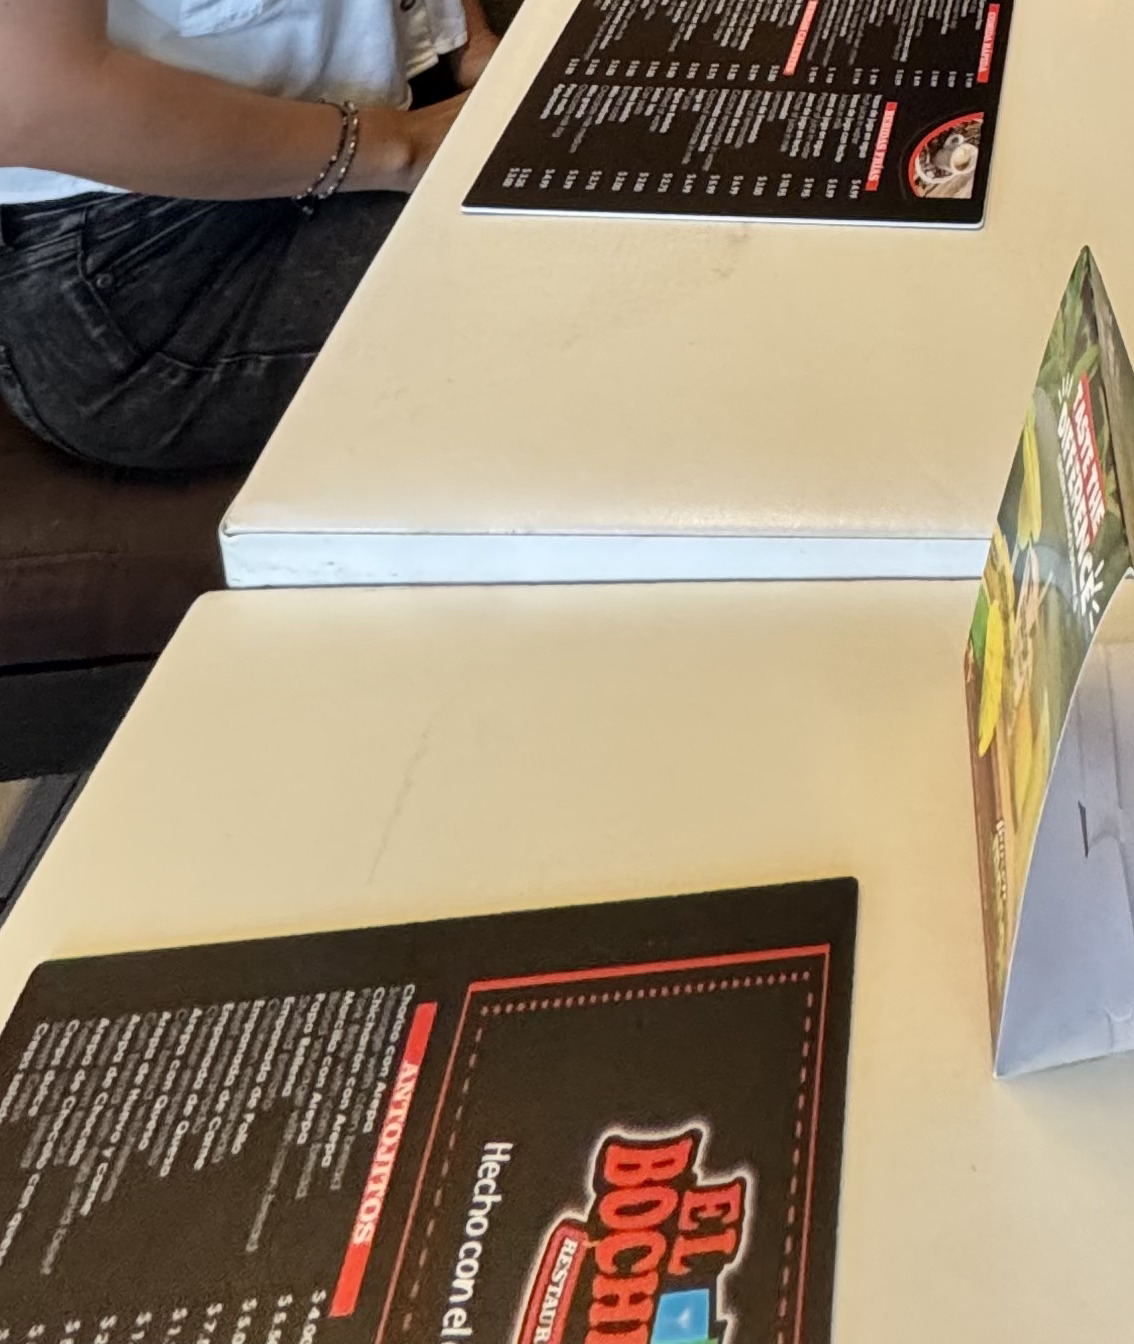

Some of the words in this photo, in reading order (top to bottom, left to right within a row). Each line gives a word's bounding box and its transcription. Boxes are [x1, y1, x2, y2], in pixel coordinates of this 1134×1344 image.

[874, 109, 896, 149] BEBIDAS
[867, 151, 886, 181] FRÍAS
[1073, 379, 1094, 479] TASTE
[1086, 462, 1105, 536] THE
[1058, 400, 1094, 616] DIFFERENCE
[141, 1010, 172, 1060] Arepa
[173, 1006, 204, 1055] Arepa
[301, 993, 325, 1033] Papa
[347, 986, 386, 1073] Chicharrón
[388, 983, 416, 1041] Chorizo
[16, 1022, 50, 1070] Creps
[48, 1019, 81, 1066] Creps
[110, 1013, 141, 1062] Arepa
[190, 1002, 234, 1089] Empanada
[222, 999, 265, 1086] Empanada
[254, 995, 296, 1082] Empanada
[377, 1045, 397, 1077] con
[99, 1066, 120, 1088] de
[130, 1062, 152, 1085] de
[159, 1058, 184, 1091] con
[279, 1036, 310, 1097] Rellena
[26, 1069, 59, 1116] dulce
[107, 1087, 141, 1143] Huevo
[179, 1094, 200, 1116] de
[212, 1089, 232, 1112] de
[244, 1086, 264, 1109] de
[335, 1076, 357, 1110] con
[359, 1081, 386, 1133] Arepa
[67, 1091, 109, 1165] Chocolo
[136, 1094, 170, 1151] Queso
[191, 1116, 223, 1170] Carne
[228, 1112, 254, 1154] Pollo
[317, 1113, 346, 1167] Arepa
[101, 1146, 118, 1158] y
[156, 1120, 190, 1177] Queso
[349, 1059, 423, 1244] ANTOJITOS
[78, 1162, 111, 1215] carne
[465, 1141, 514, 1238] Hecho
[667, 1181, 742, 1276] EL
[312, 1290, 326, 1303] $
[449, 1240, 485, 1304] con
[242, 1298, 257, 1311] $
[278, 1294, 293, 1306] $
[440, 1306, 472, 1337] el
